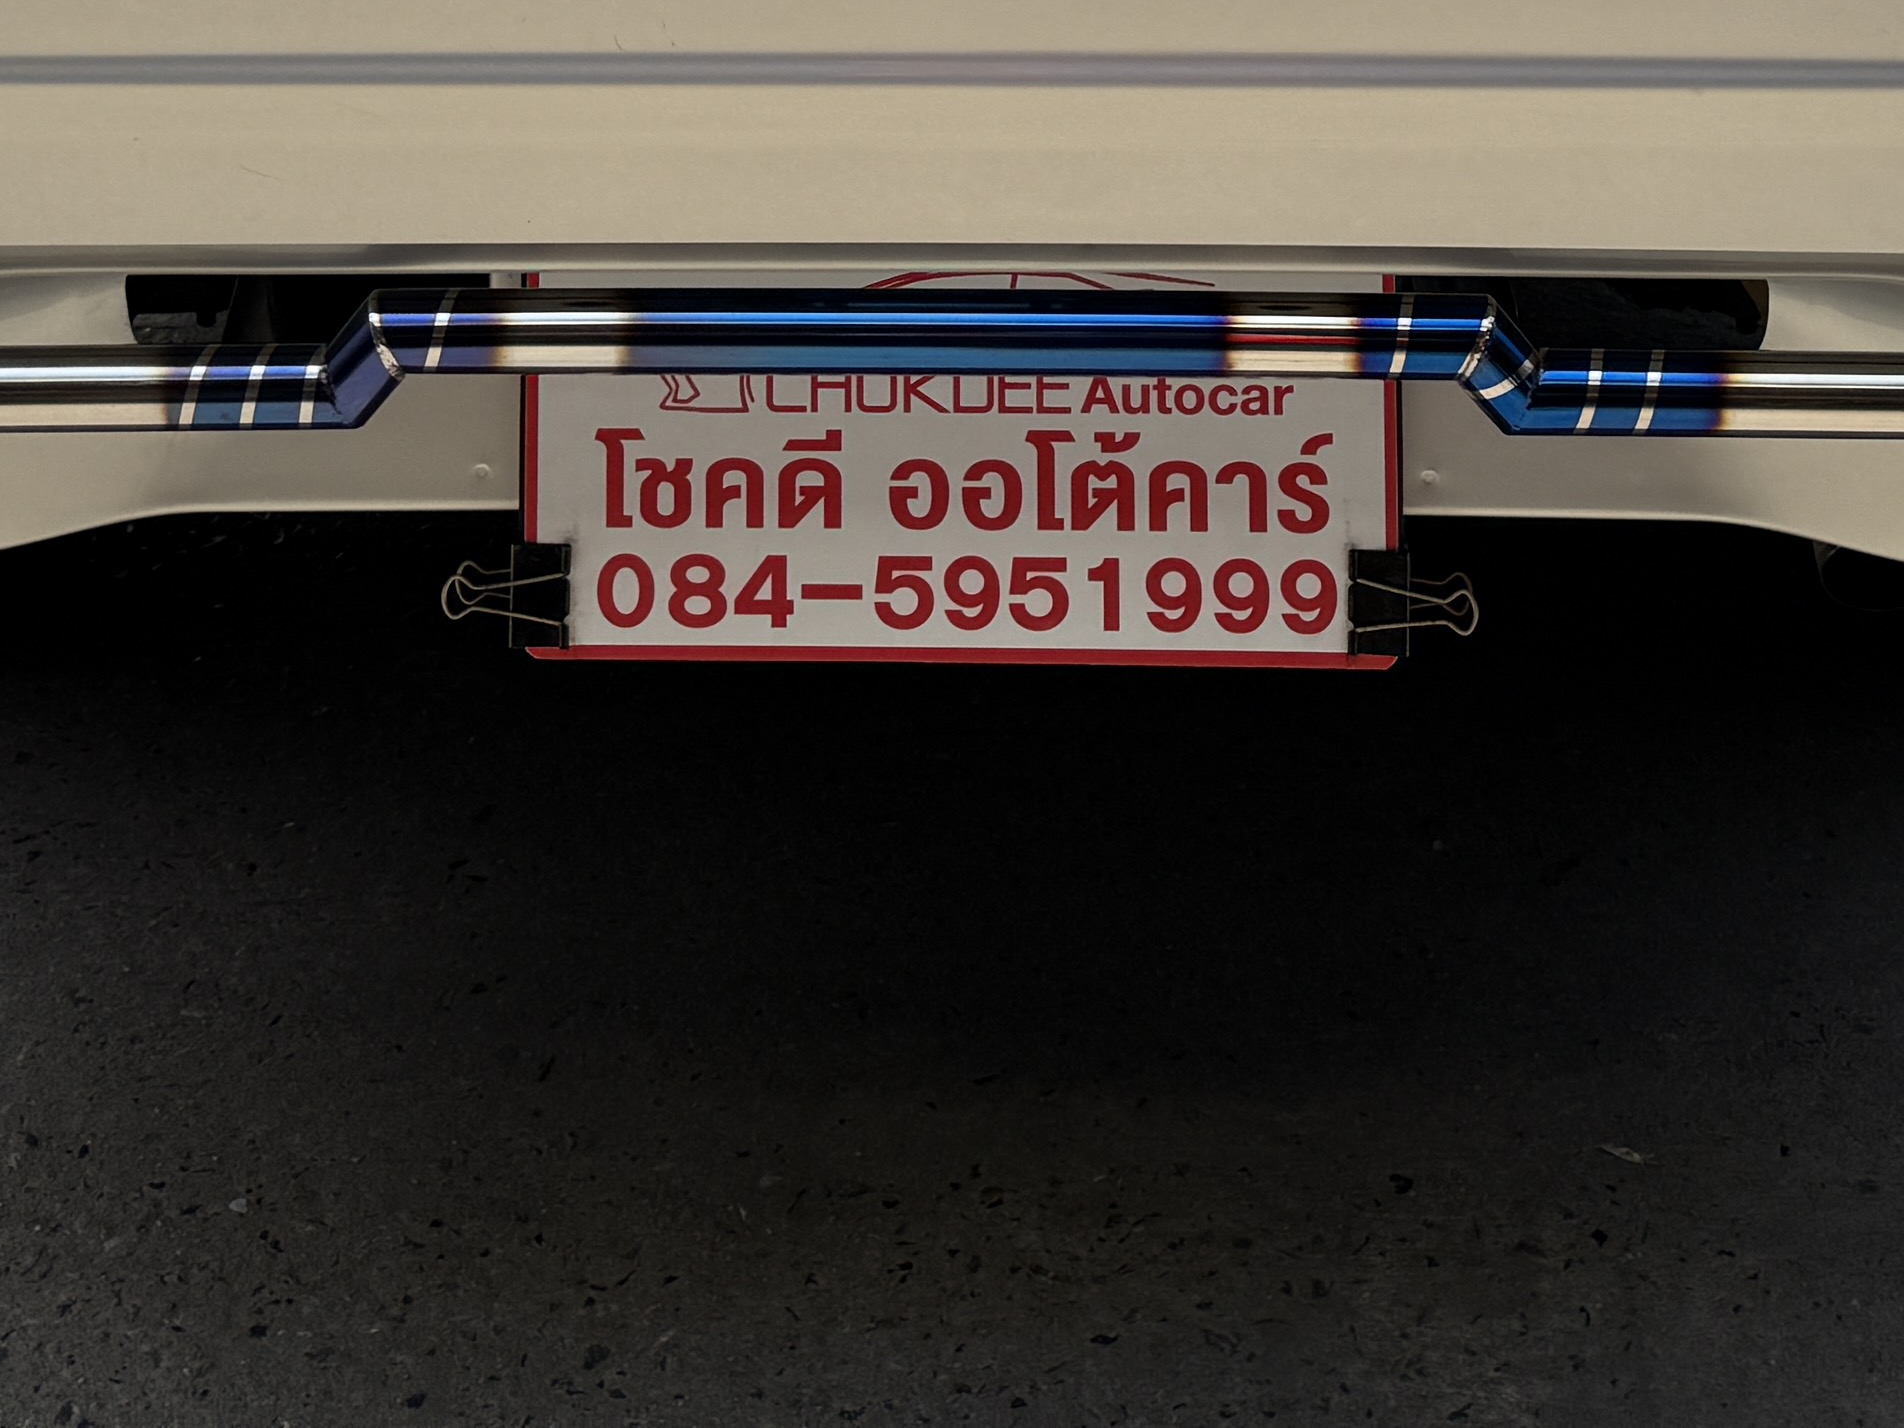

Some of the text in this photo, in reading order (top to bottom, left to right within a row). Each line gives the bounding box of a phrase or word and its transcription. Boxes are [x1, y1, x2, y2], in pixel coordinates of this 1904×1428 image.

[1080, 375, 1296, 416] Autocar
[595, 427, 1336, 535] โชคดี ออโต้คาร์
[595, 552, 1339, 636] 084-5951999
